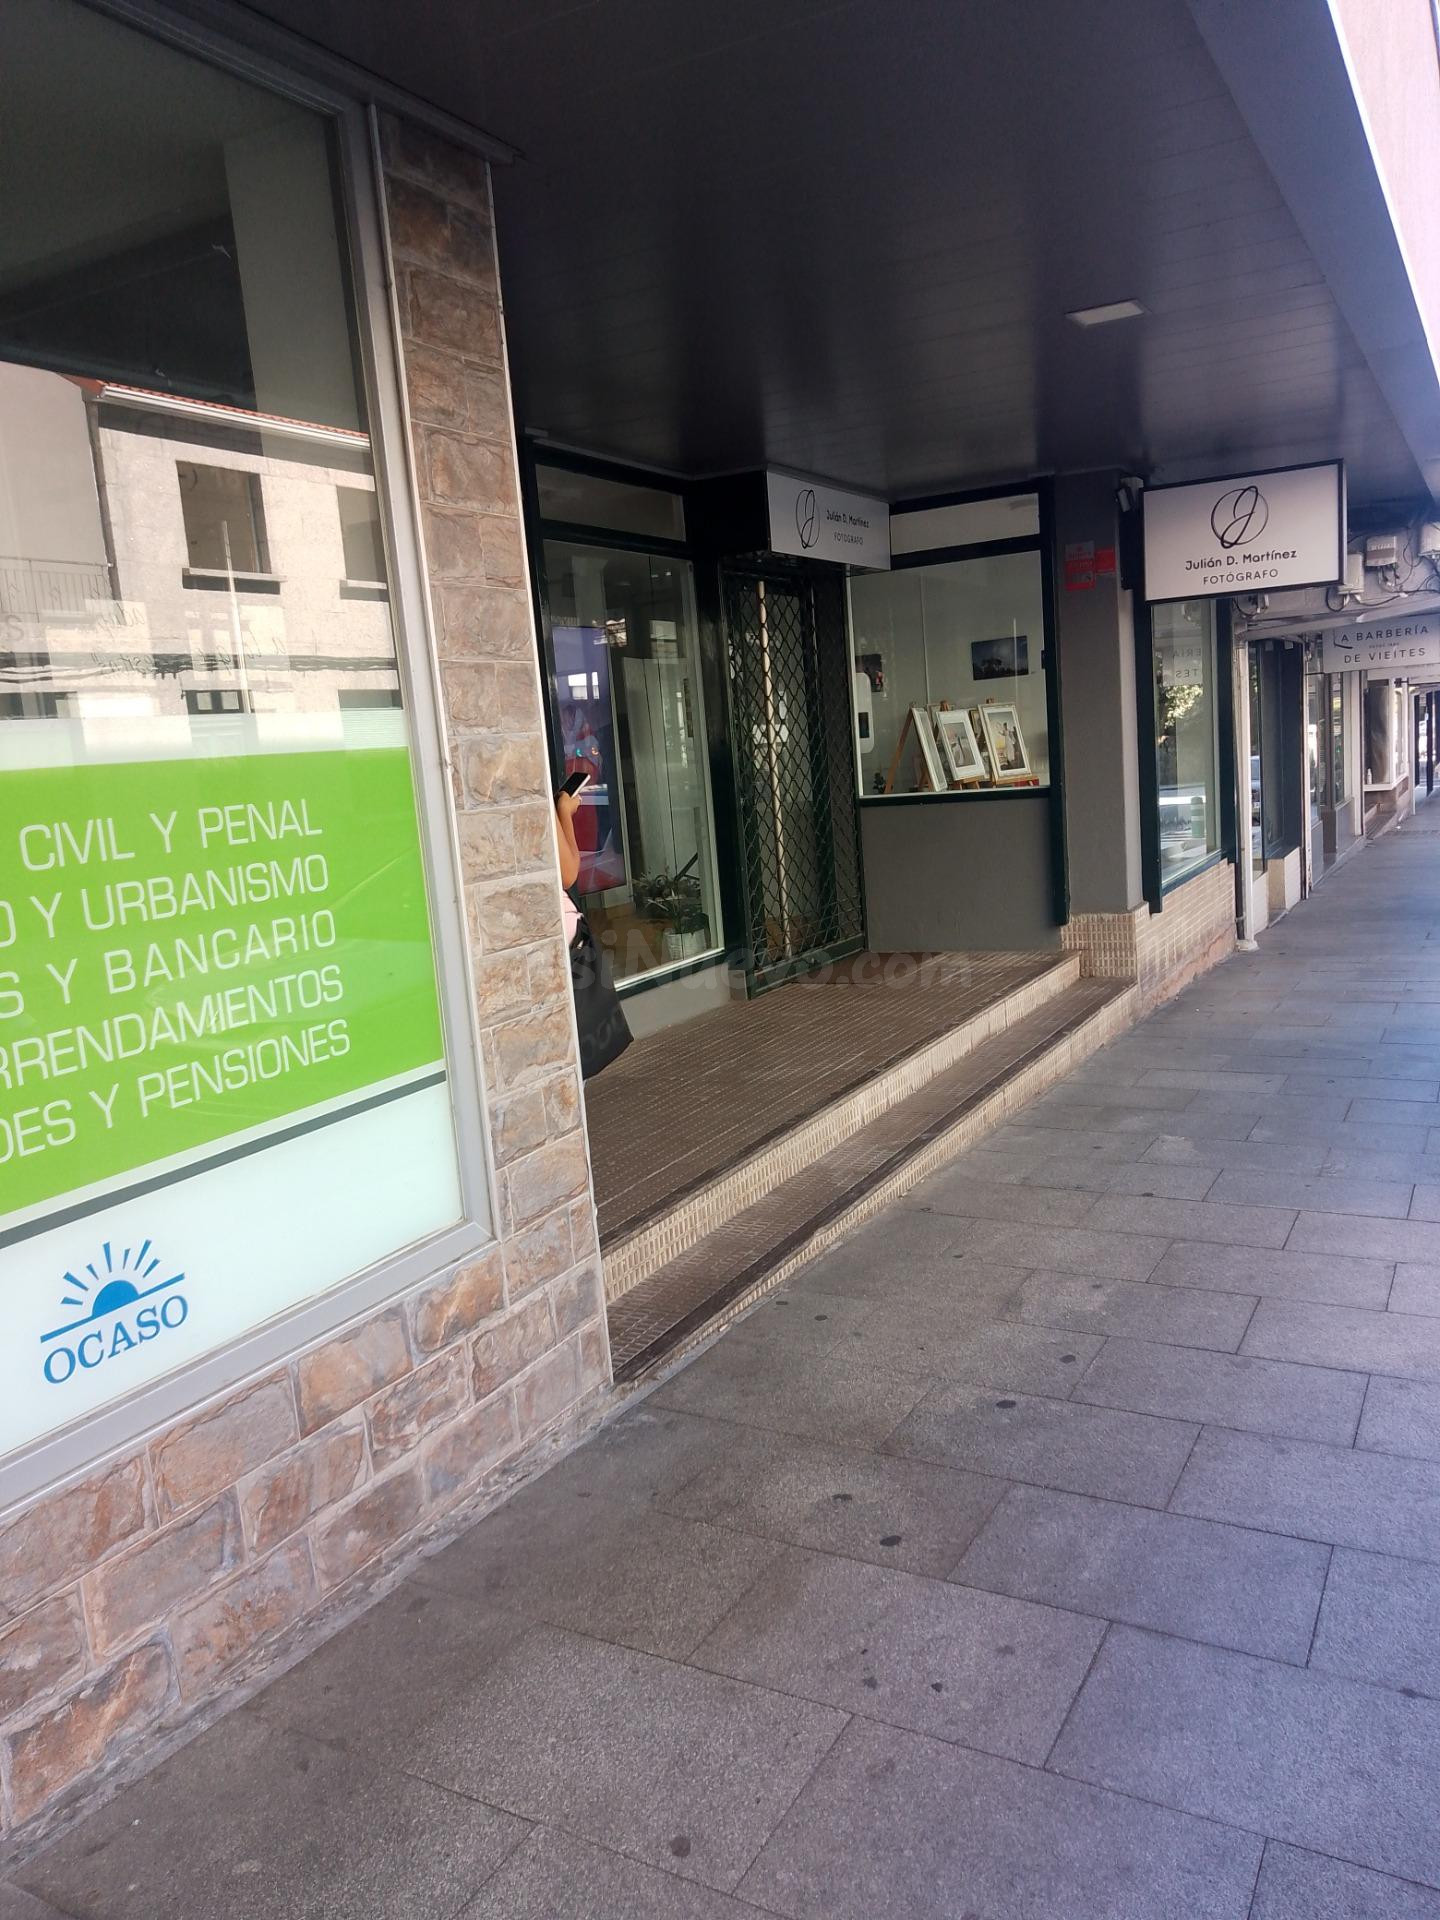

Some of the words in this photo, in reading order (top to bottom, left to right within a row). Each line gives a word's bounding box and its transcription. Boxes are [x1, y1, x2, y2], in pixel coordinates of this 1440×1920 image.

[1185, 557, 1222, 571] Julián
[1226, 556, 1239, 566] D.
[1243, 550, 1297, 564] Martínez
[1203, 568, 1279, 585] FOTÓGRAFO
[1344, 653, 1361, 664] DE
[1356, 625, 1429, 641] BARBERÍA
[19, 818, 134, 872] CIVIL
[150, 811, 177, 853] Y
[198, 798, 323, 849] PENAL
[30, 892, 62, 939] Y
[81, 854, 329, 931] URBANISMO
[46, 958, 78, 1004] Y
[104, 909, 336, 994] BANCARIO
[89, 1083, 120, 1129] Y
[137, 1019, 351, 1117] PENSIONES
[43, 1294, 189, 1385] OCASO
